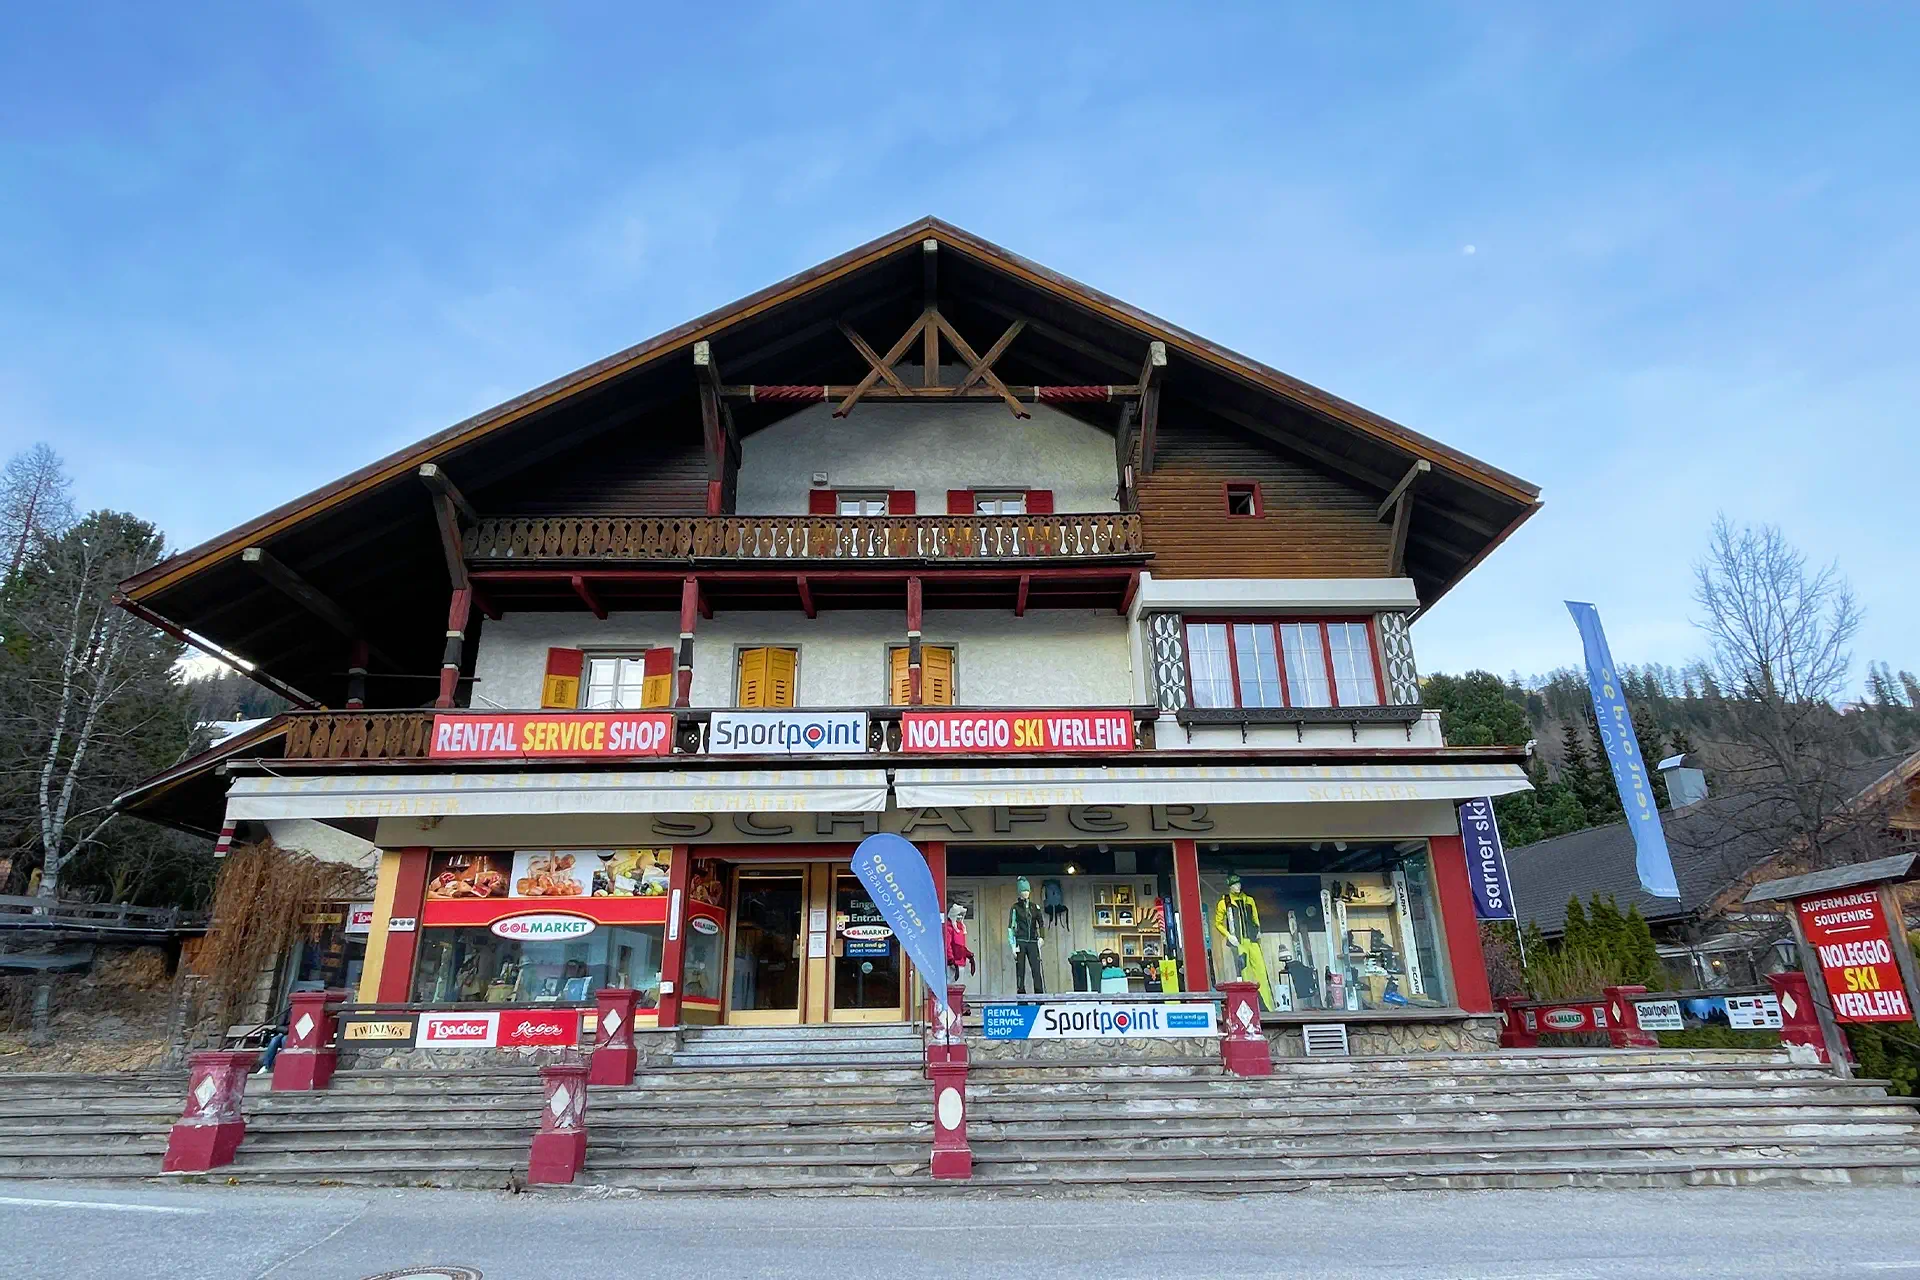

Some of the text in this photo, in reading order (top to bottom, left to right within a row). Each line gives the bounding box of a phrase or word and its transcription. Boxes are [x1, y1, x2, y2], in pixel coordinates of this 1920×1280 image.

[436, 719, 667, 752] RENTAL SERVICE SHOP
[716, 719, 861, 750] Sportpoint
[907, 717, 1127, 748] NOLEGGIO SKI VERLEIH
[1467, 801, 1502, 909] sarner ski
[850, 899, 876, 910] Einga
[1801, 891, 1879, 913] SUPERMARKET
[498, 921, 587, 934] GOLMARKET
[1814, 910, 1873, 926] SOUVENIRS
[1818, 938, 1891, 969] NOLEGGIO
[1843, 966, 1881, 992] SKI
[987, 1008, 1022, 1018] RENTAL
[1832, 990, 1908, 1017] VERLEIH
[352, 1022, 405, 1038] TWININGS
[430, 1020, 487, 1039] Loacker
[511, 1021, 562, 1038] Reber
[987, 1017, 1025, 1027] SERVICE
[987, 1027, 1012, 1036] SHOP
[1044, 1008, 1160, 1035] Sportpoint
